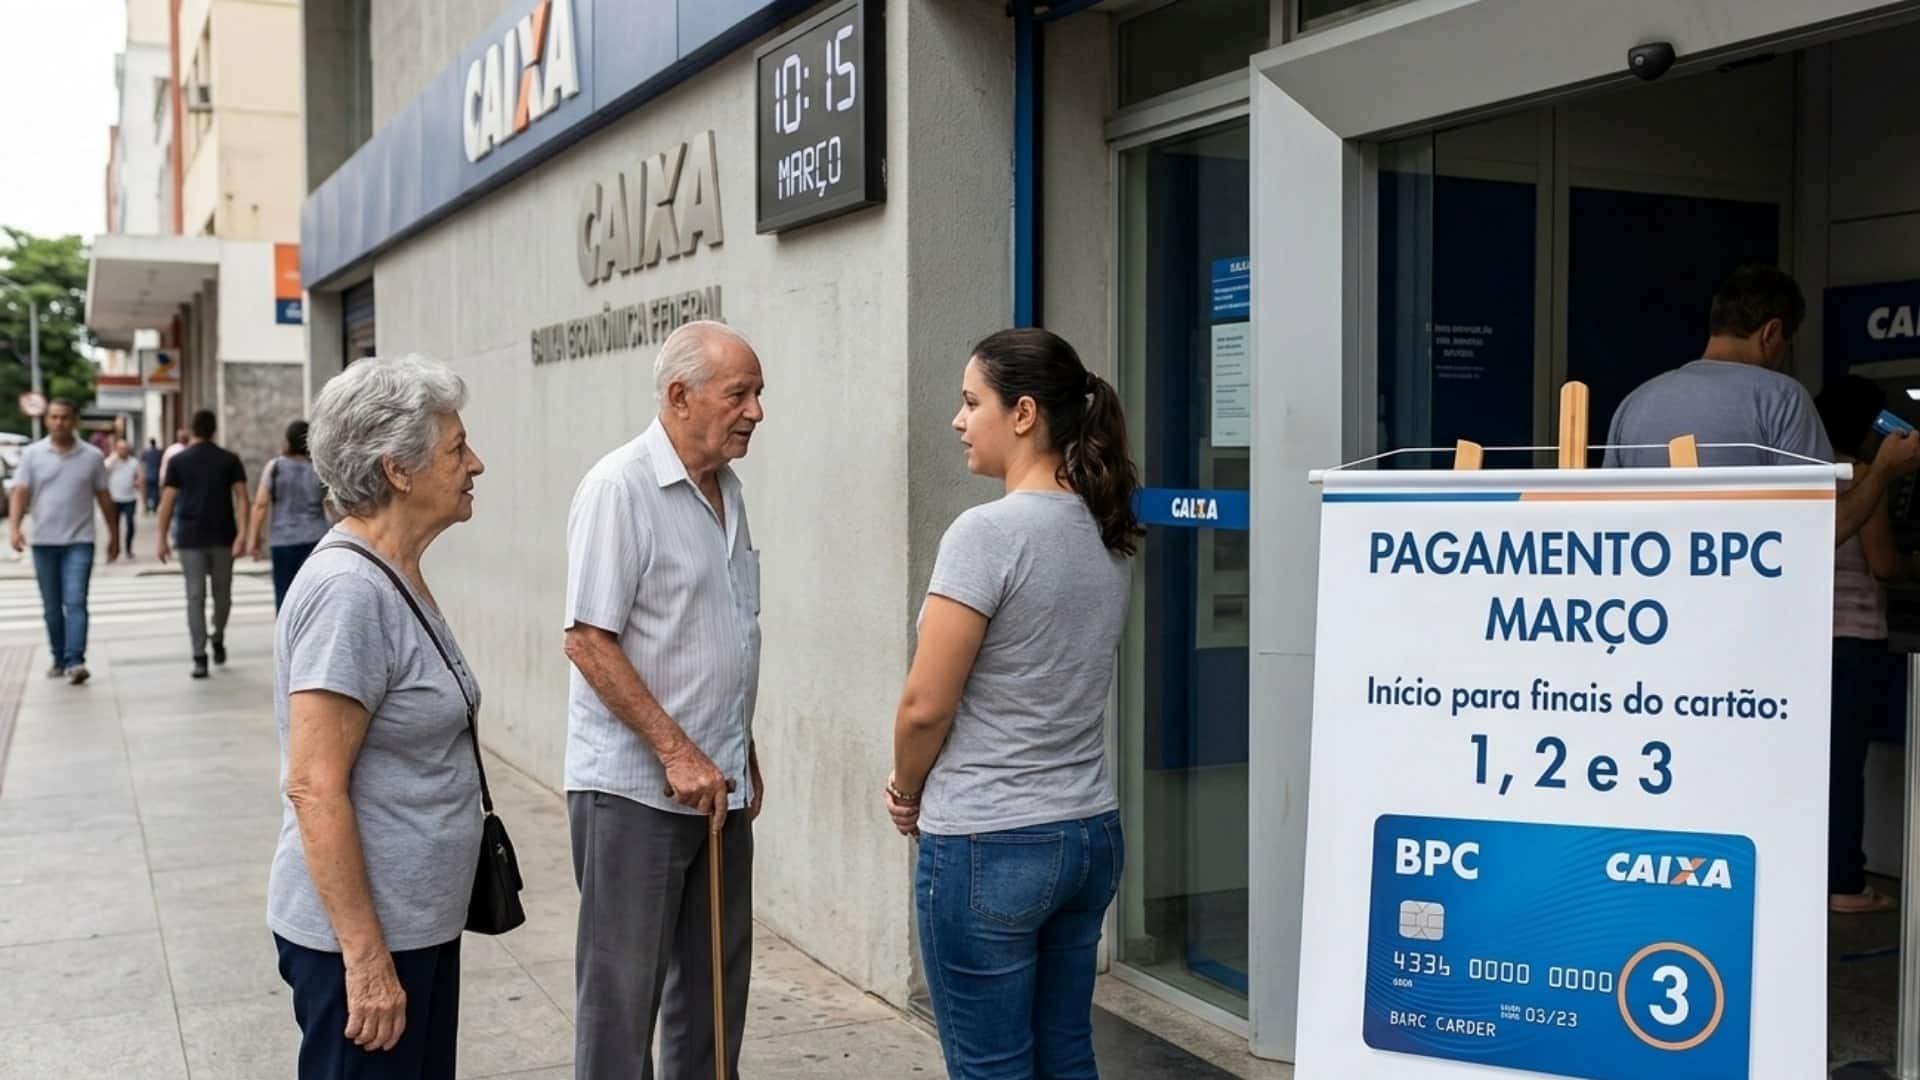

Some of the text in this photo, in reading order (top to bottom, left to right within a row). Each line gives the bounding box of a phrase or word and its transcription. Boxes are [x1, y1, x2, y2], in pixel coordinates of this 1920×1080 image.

[464, 0, 579, 163] CAIXA
[778, 135, 841, 198] MARÇO
[577, 129, 724, 287] CAIXA
[1368, 530, 1783, 578] PAGAMENTO BPC
[1485, 596, 1669, 655] MARÇO
[1367, 675, 1788, 720] Início para finais do cartão:
[1470, 733, 1673, 796] 1, 2 e 3
[1395, 837, 1480, 881] BPC
[1605, 852, 1733, 890] CAIXA
[1469, 958, 1530, 985] 0000
[1549, 966, 1613, 993] 0000
[1648, 965, 1690, 1026] 3
[1389, 1010, 1497, 1038] BARC CARDER
[1525, 1007, 1578, 1029] 03/23
